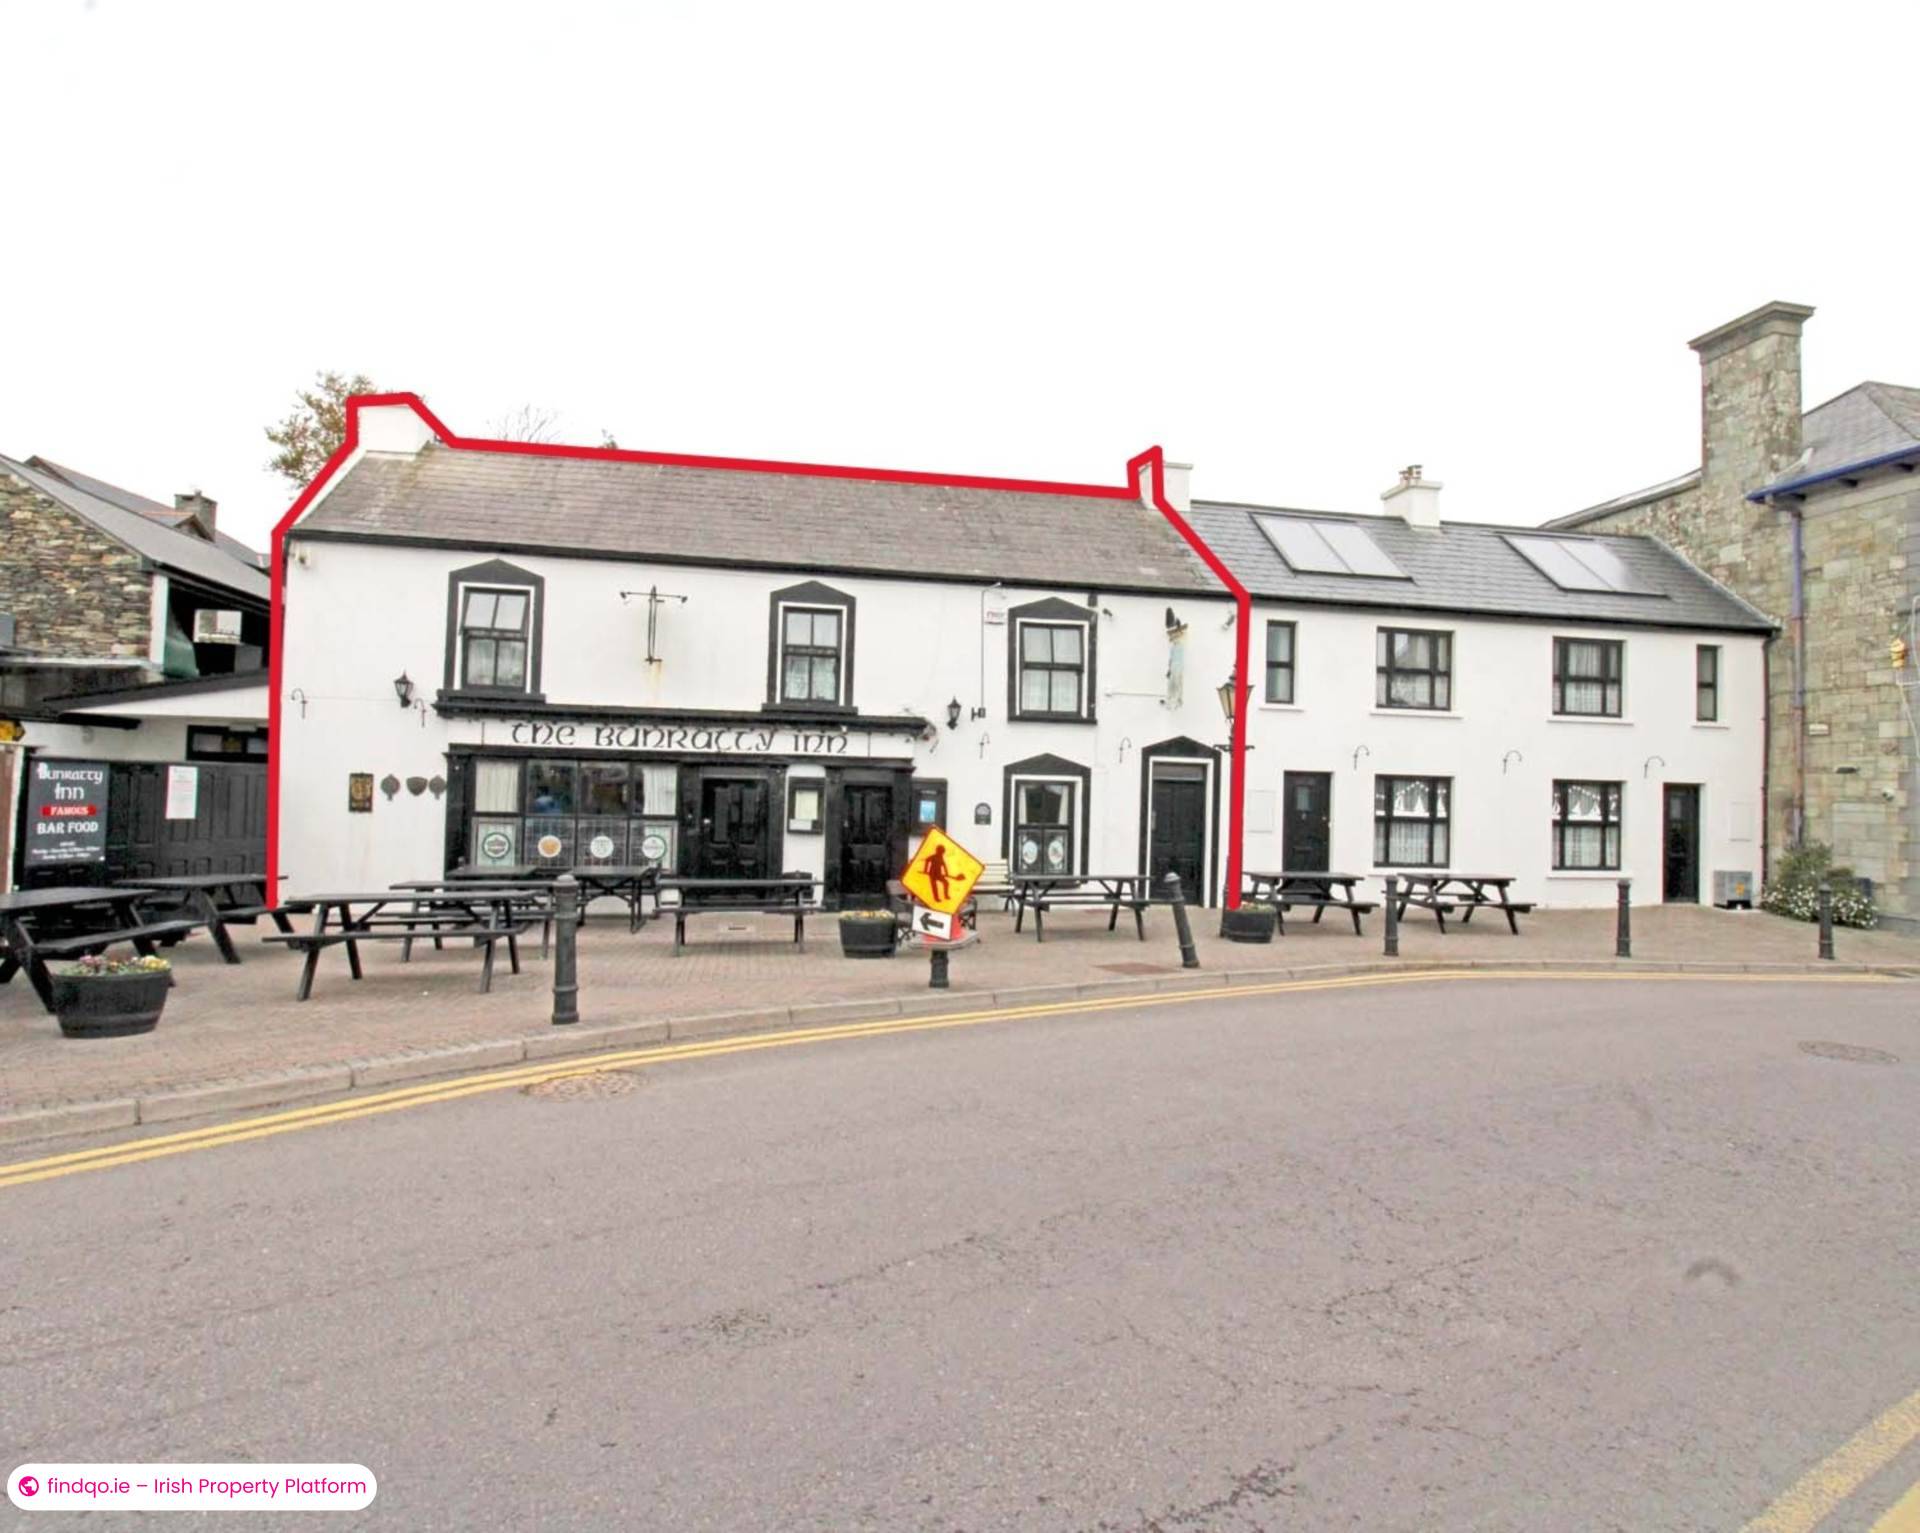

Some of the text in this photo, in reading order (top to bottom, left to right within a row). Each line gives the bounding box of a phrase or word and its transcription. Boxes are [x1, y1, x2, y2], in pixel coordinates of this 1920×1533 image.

[50, 806, 89, 816] FAMOUS
[37, 821, 98, 835] BAR FOOD
